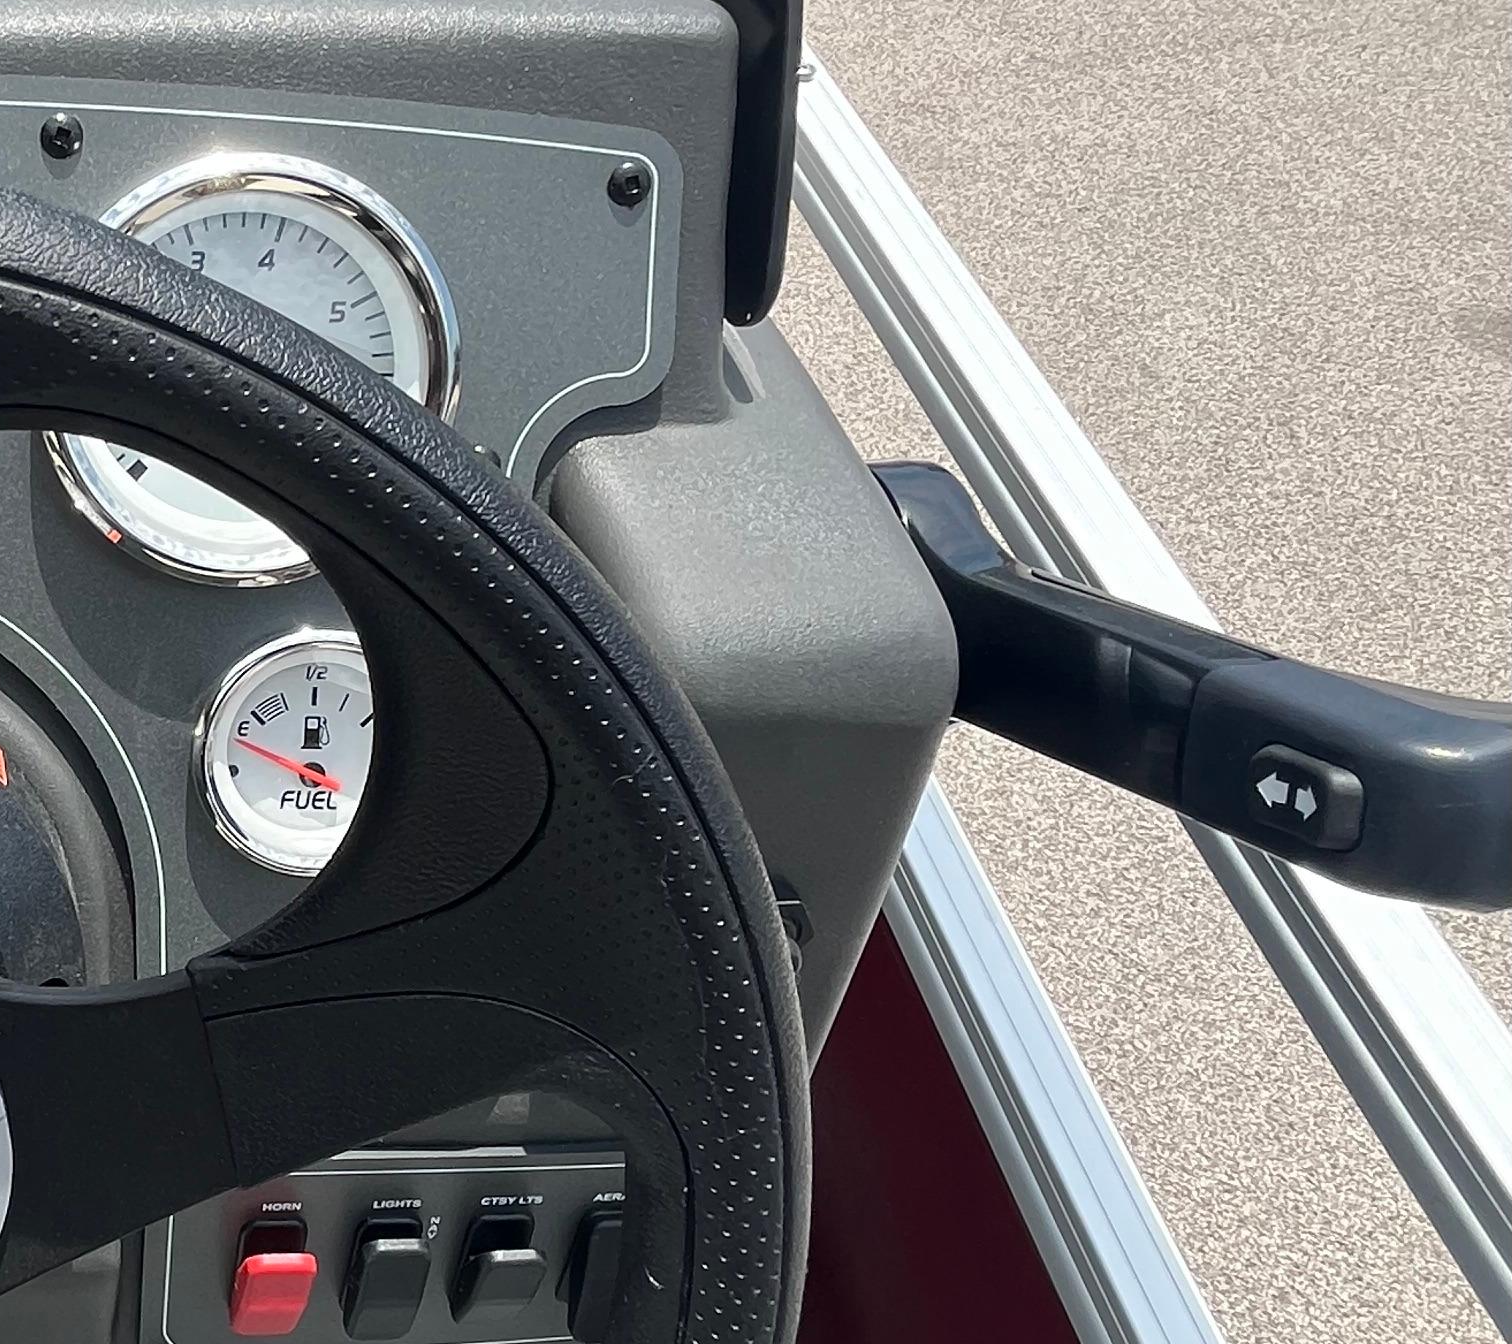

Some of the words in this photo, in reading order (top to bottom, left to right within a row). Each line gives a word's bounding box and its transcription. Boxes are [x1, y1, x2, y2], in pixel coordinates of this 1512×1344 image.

[257, 249, 276, 271] 4
[328, 301, 347, 323] 5
[305, 665, 328, 681] 1/2
[237, 720, 250, 737] E
[280, 790, 337, 810] FUEL
[262, 1202, 302, 1212] HORN
[372, 1199, 422, 1209] LIGHTS
[480, 1196, 517, 1206] CTSY
[518, 1195, 544, 1205] LTS
